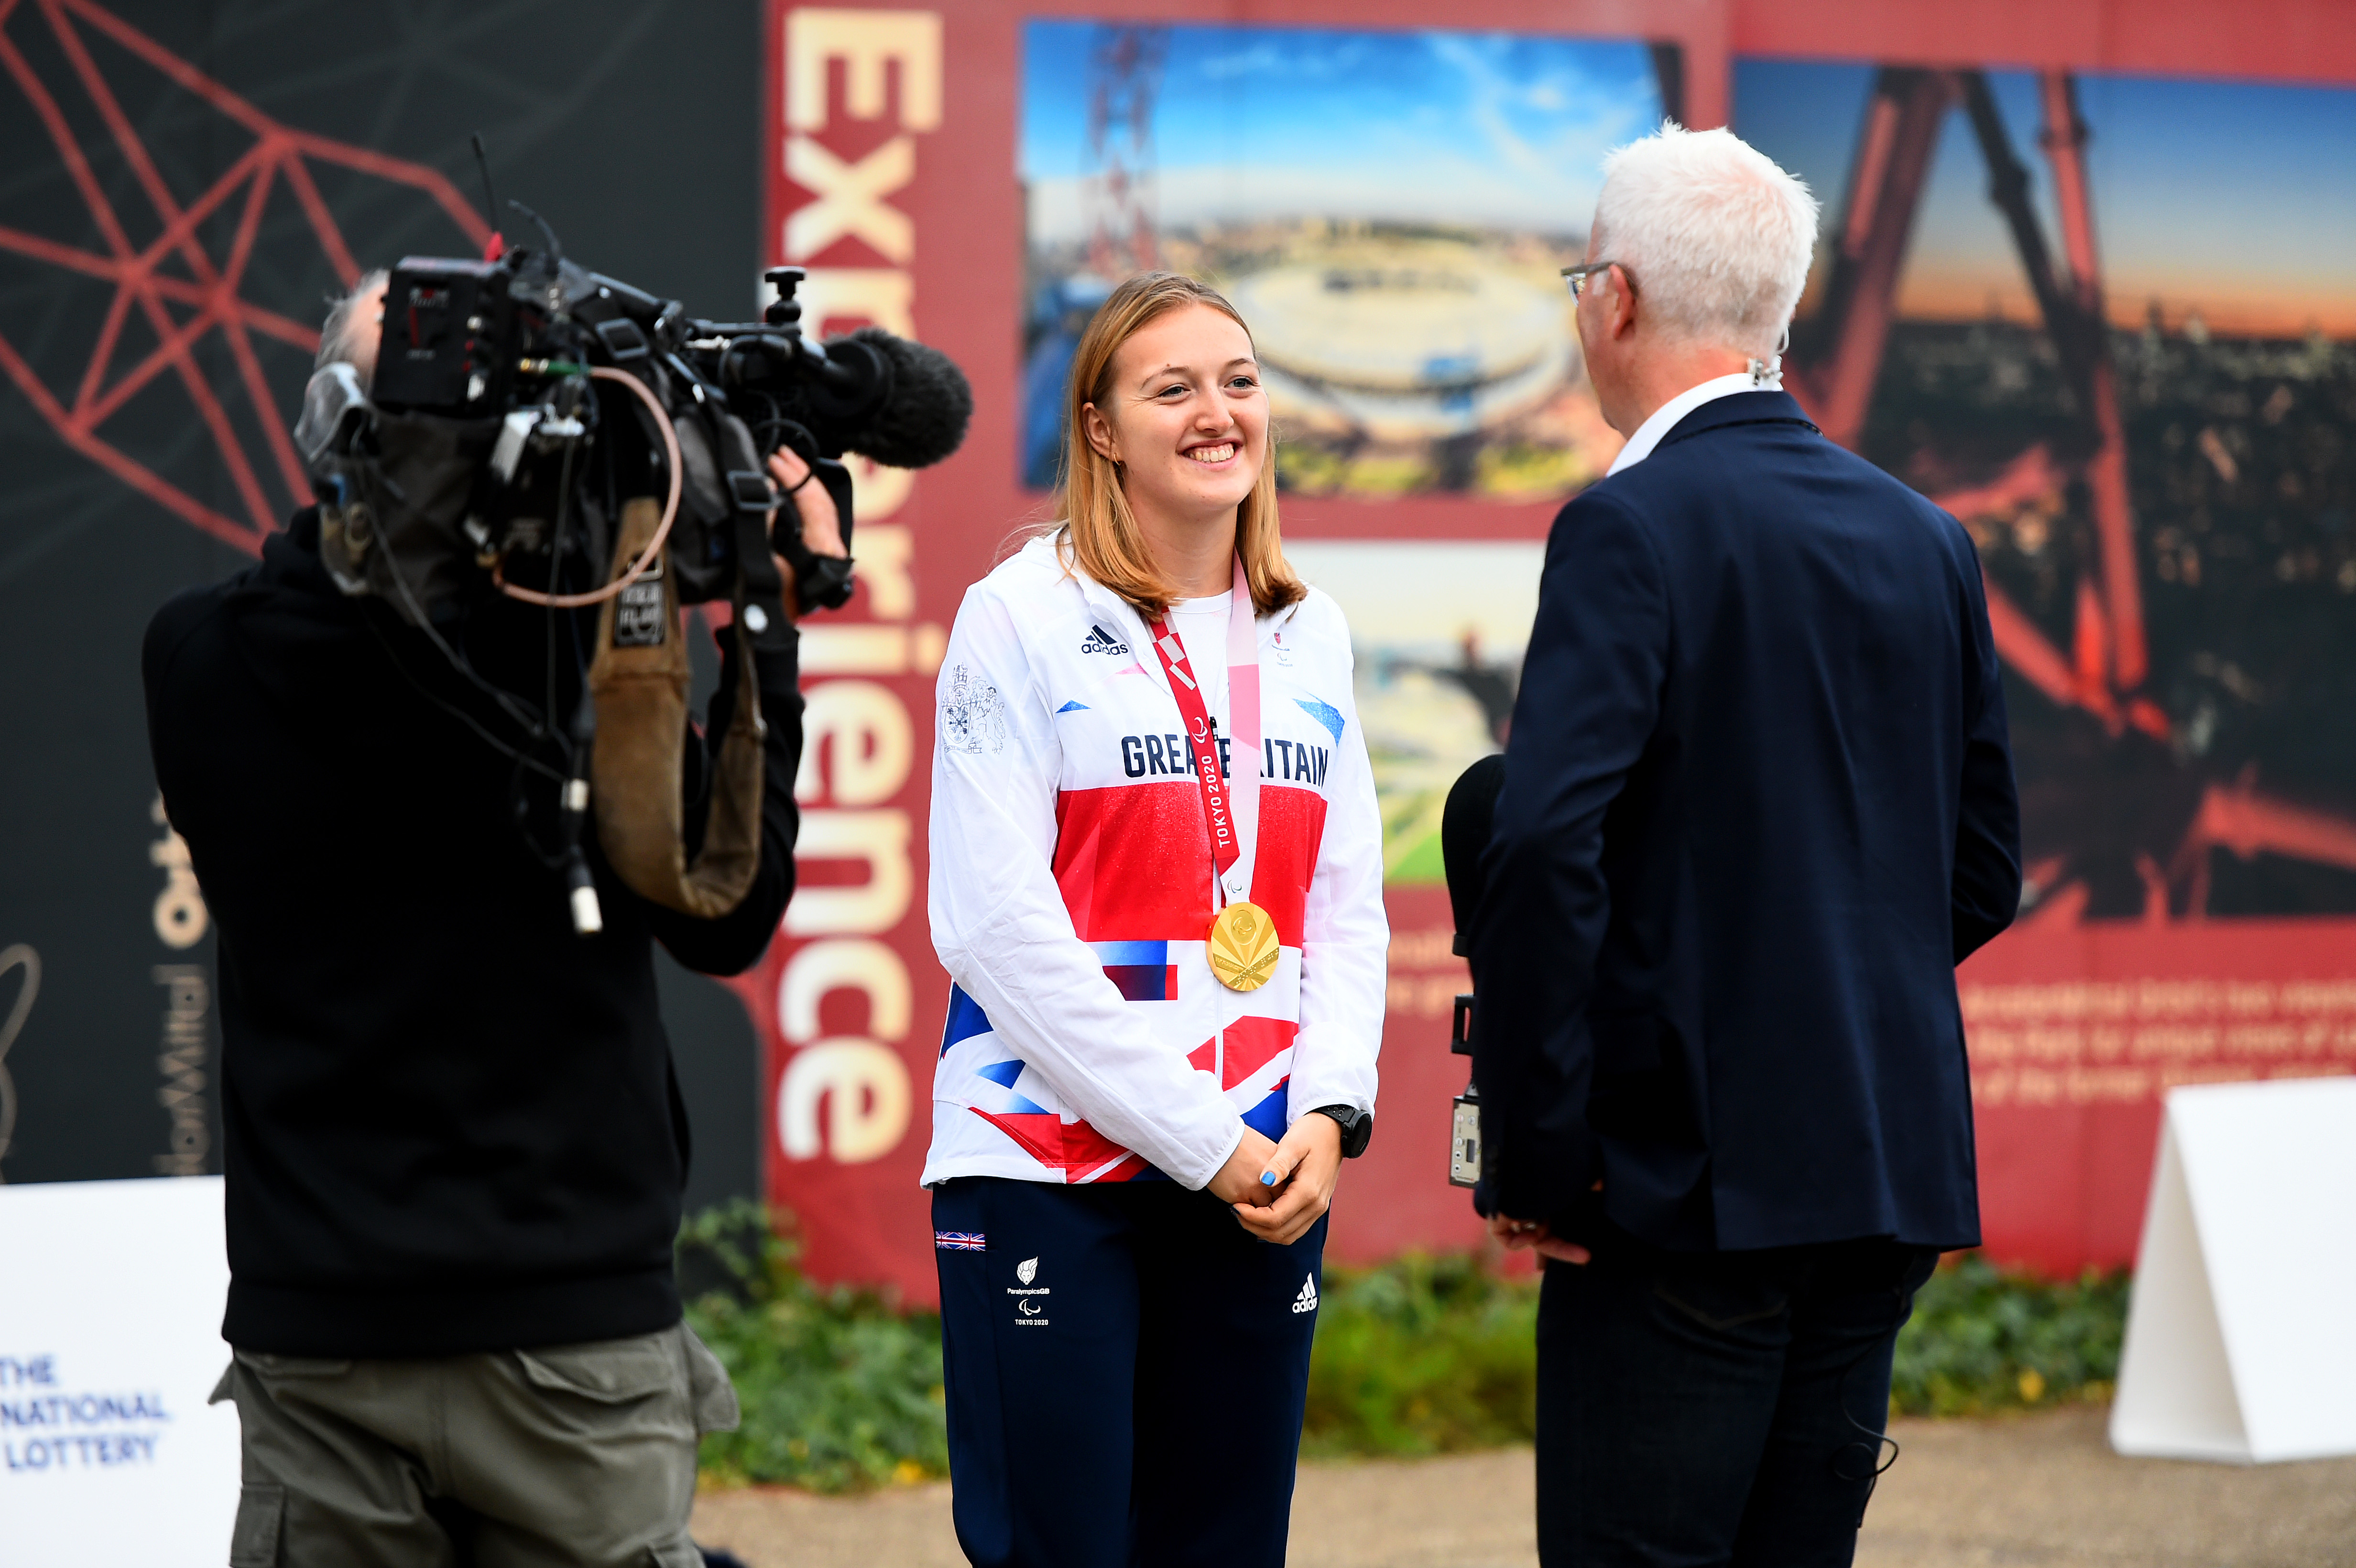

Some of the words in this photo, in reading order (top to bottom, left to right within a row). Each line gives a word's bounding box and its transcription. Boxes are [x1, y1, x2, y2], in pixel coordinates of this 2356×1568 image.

[1081, 642, 1128, 655] adidas
[1121, 734, 1199, 778] GREA
[1219, 738, 1329, 790] BITAIN
[1201, 755, 1220, 794] 2020
[1211, 797, 1231, 849] TOKYO
[0, 1356, 55, 1385] THE
[0, 1393, 168, 1426] NATIONAL
[6, 1436, 158, 1470] LOTTERY
